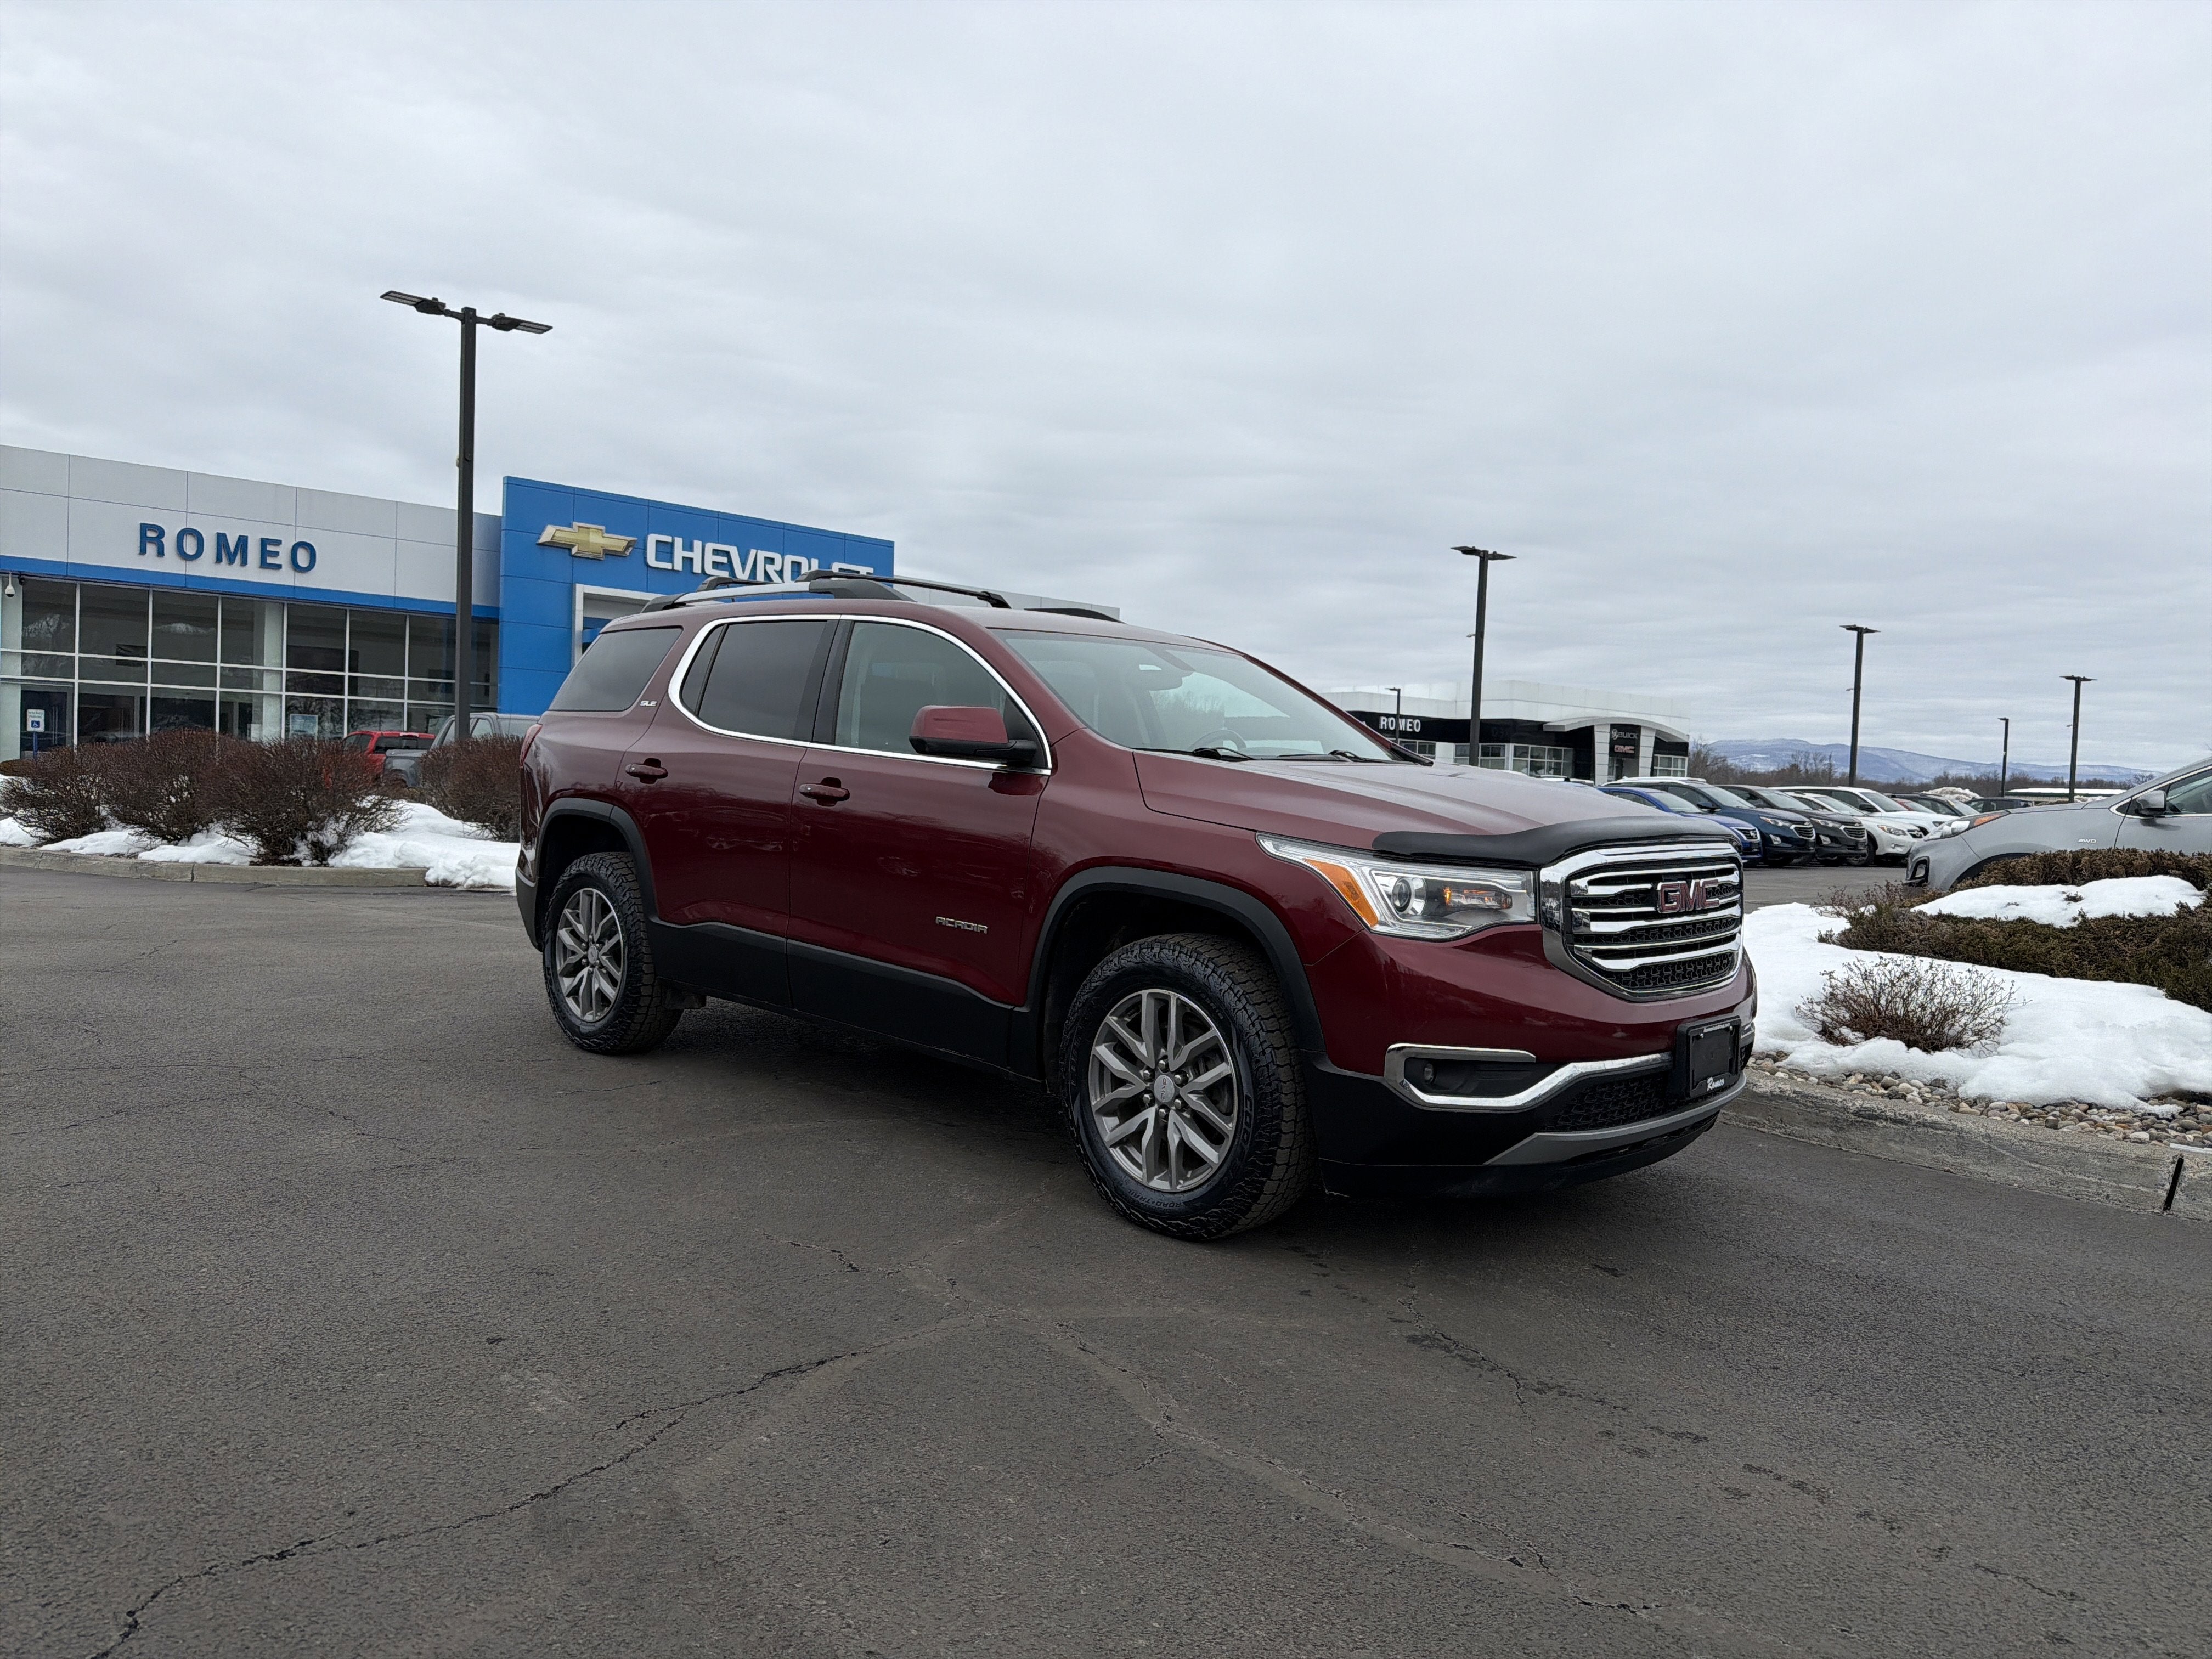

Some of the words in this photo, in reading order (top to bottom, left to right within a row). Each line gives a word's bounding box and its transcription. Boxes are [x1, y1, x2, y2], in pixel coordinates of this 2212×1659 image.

[138, 523, 317, 573] ROMEO
[647, 533, 874, 583] CHEVRO
[1379, 716, 1421, 732] ROMEO
[1618, 731, 1638, 740] BUICK
[1614, 745, 1635, 754] GMC
[1657, 878, 1720, 913] GMC
[935, 916, 988, 934] ACADIA
[1707, 1077, 1725, 1092] Romeo
